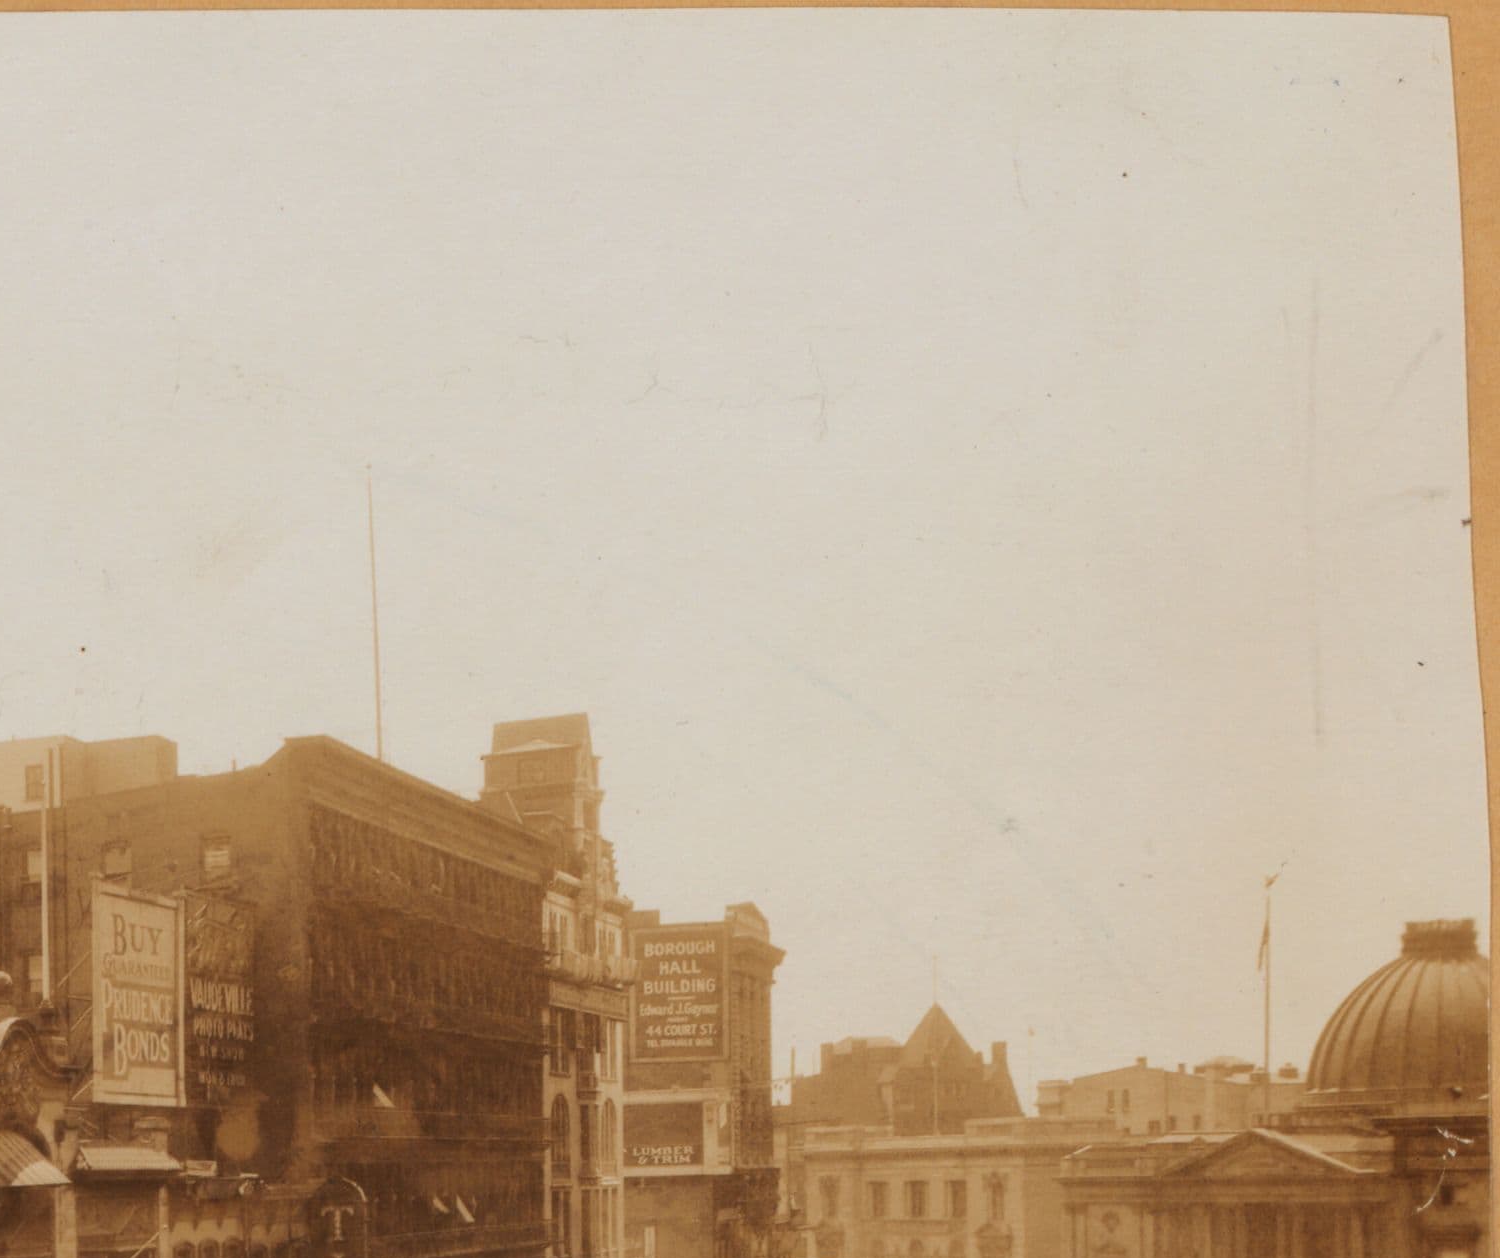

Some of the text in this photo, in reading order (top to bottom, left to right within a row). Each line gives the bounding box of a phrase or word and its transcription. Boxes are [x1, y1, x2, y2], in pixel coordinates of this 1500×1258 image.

[112, 913, 163, 956] BUY
[644, 939, 716, 958] BOROUGH
[659, 958, 701, 976] HALL
[190, 976, 254, 1017] VAUDEVILLE
[643, 977, 716, 996] BUILDING
[103, 979, 174, 1033] PRUDENCE
[193, 1015, 224, 1039] PHOTO
[645, 1024, 662, 1037] 44
[664, 1024, 698, 1037] COURT
[113, 1022, 170, 1077] BONDS
